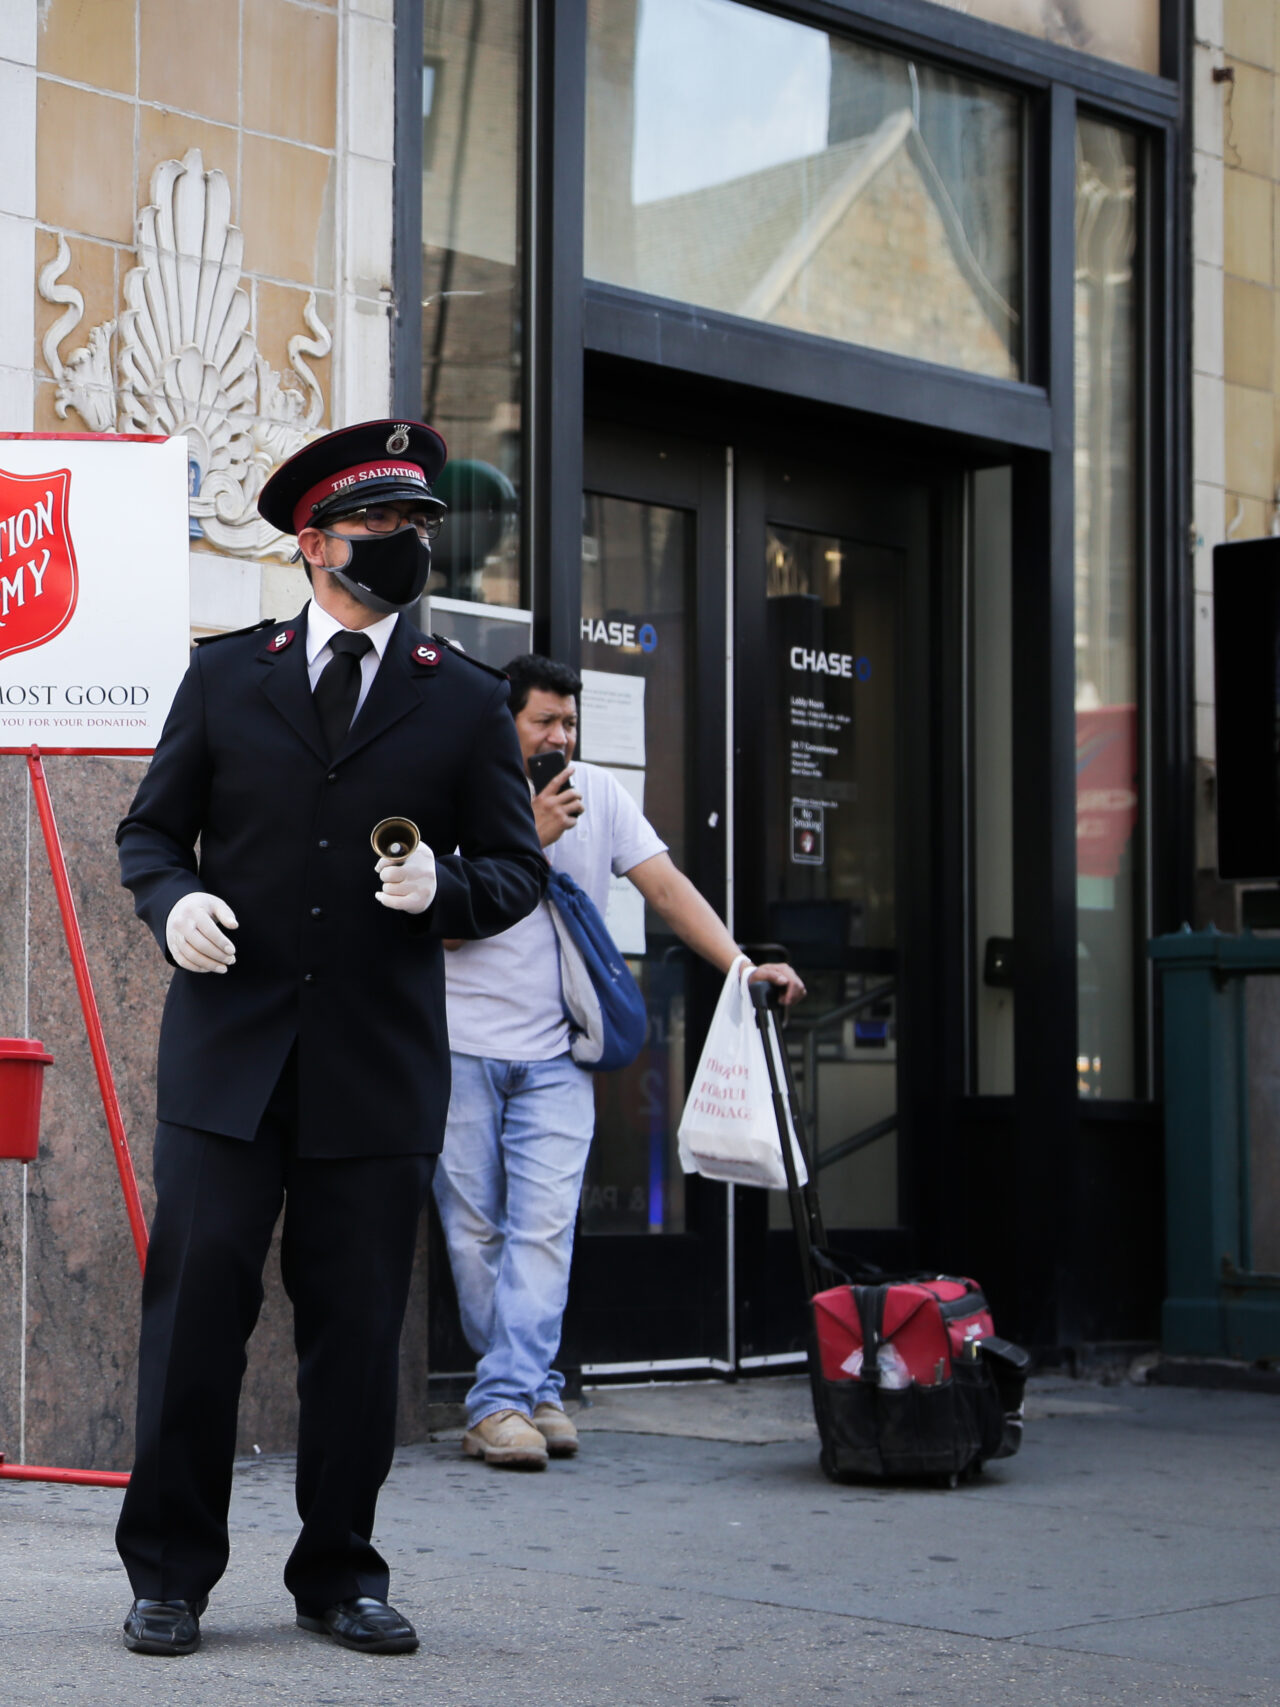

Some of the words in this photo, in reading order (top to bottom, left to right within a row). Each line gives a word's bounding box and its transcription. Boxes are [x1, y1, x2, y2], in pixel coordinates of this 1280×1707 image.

[331, 474, 356, 491] THE
[358, 467, 421, 481] SALVATION
[274, 634, 288, 648] S
[580, 617, 636, 648] HASE
[417, 646, 436, 661] S
[790, 646, 853, 678] CHASE
[64, 685, 151, 707] GOOD
[1, 718, 26, 728] YOU
[27, 718, 51, 728] FOR
[53, 718, 85, 728] YOUR
